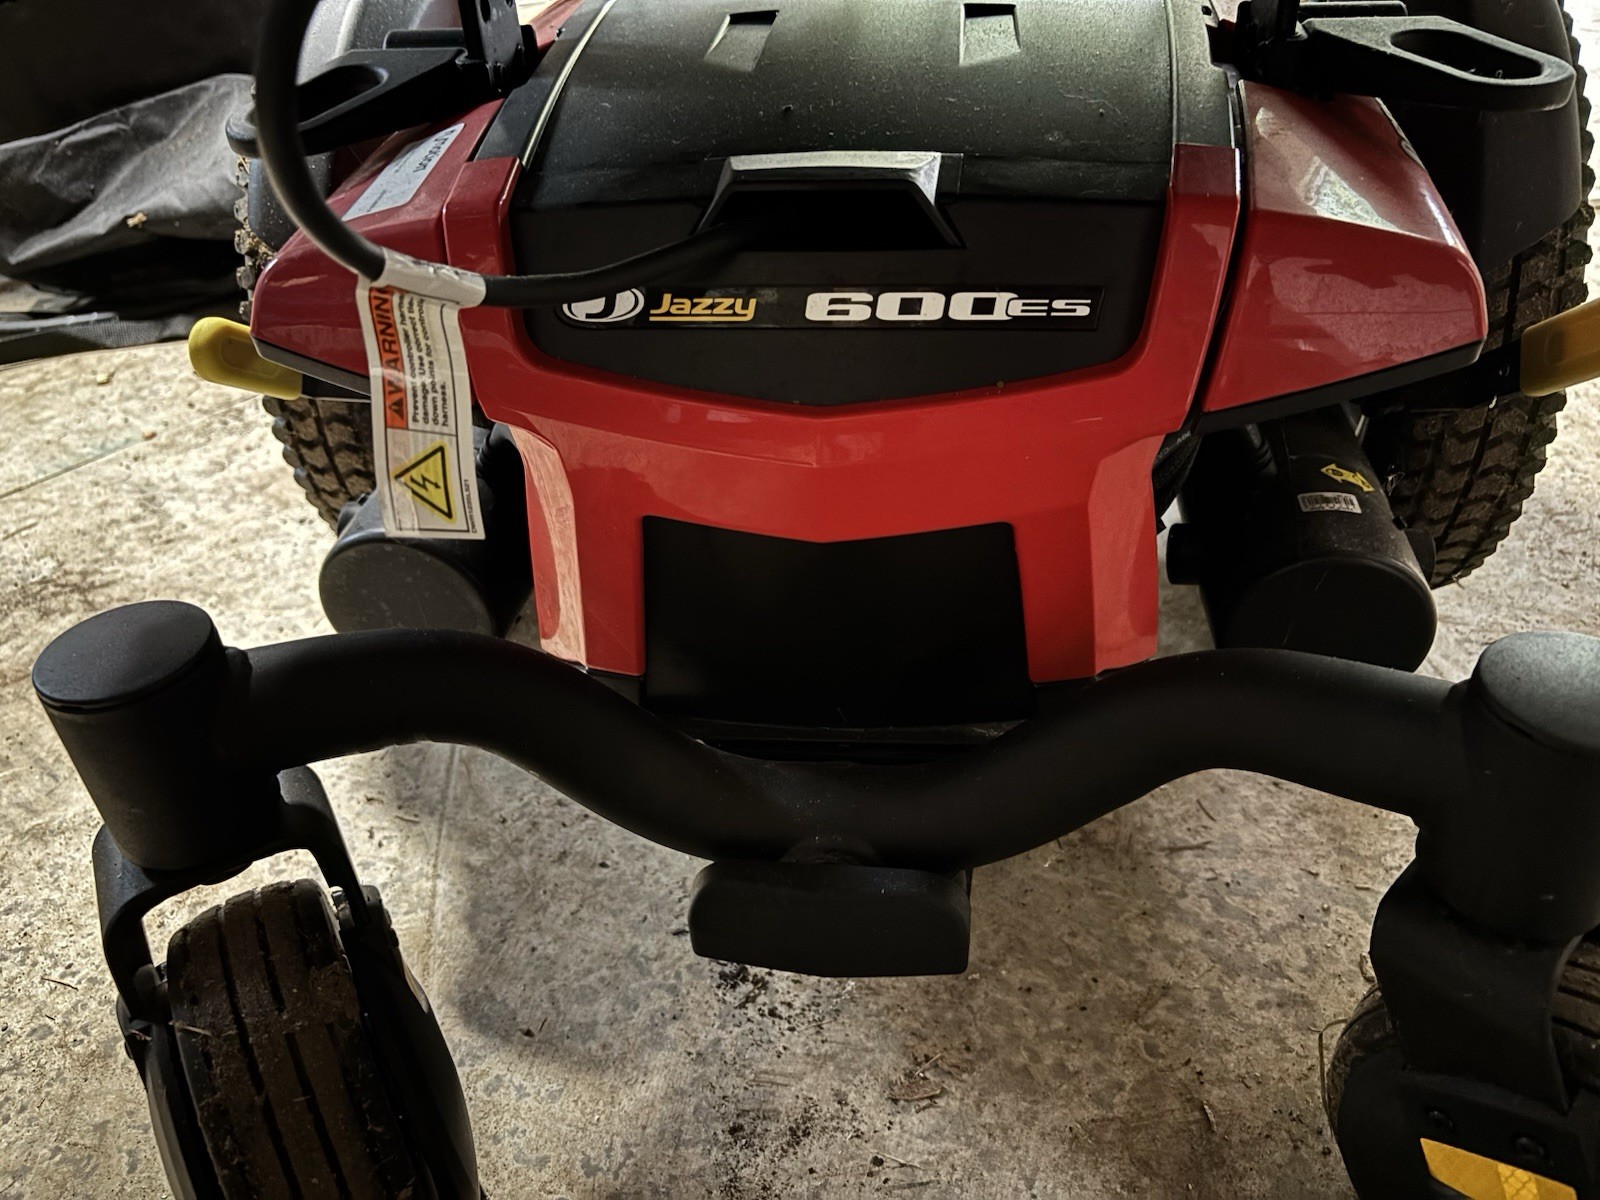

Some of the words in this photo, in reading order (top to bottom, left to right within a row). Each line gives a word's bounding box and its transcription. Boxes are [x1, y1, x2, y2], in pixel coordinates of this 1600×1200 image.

[649, 293, 757, 321] Jazzy
[409, 316, 422, 353] correct
[425, 343, 433, 357] for
[418, 355, 426, 375] Use
[431, 395, 440, 426] down
